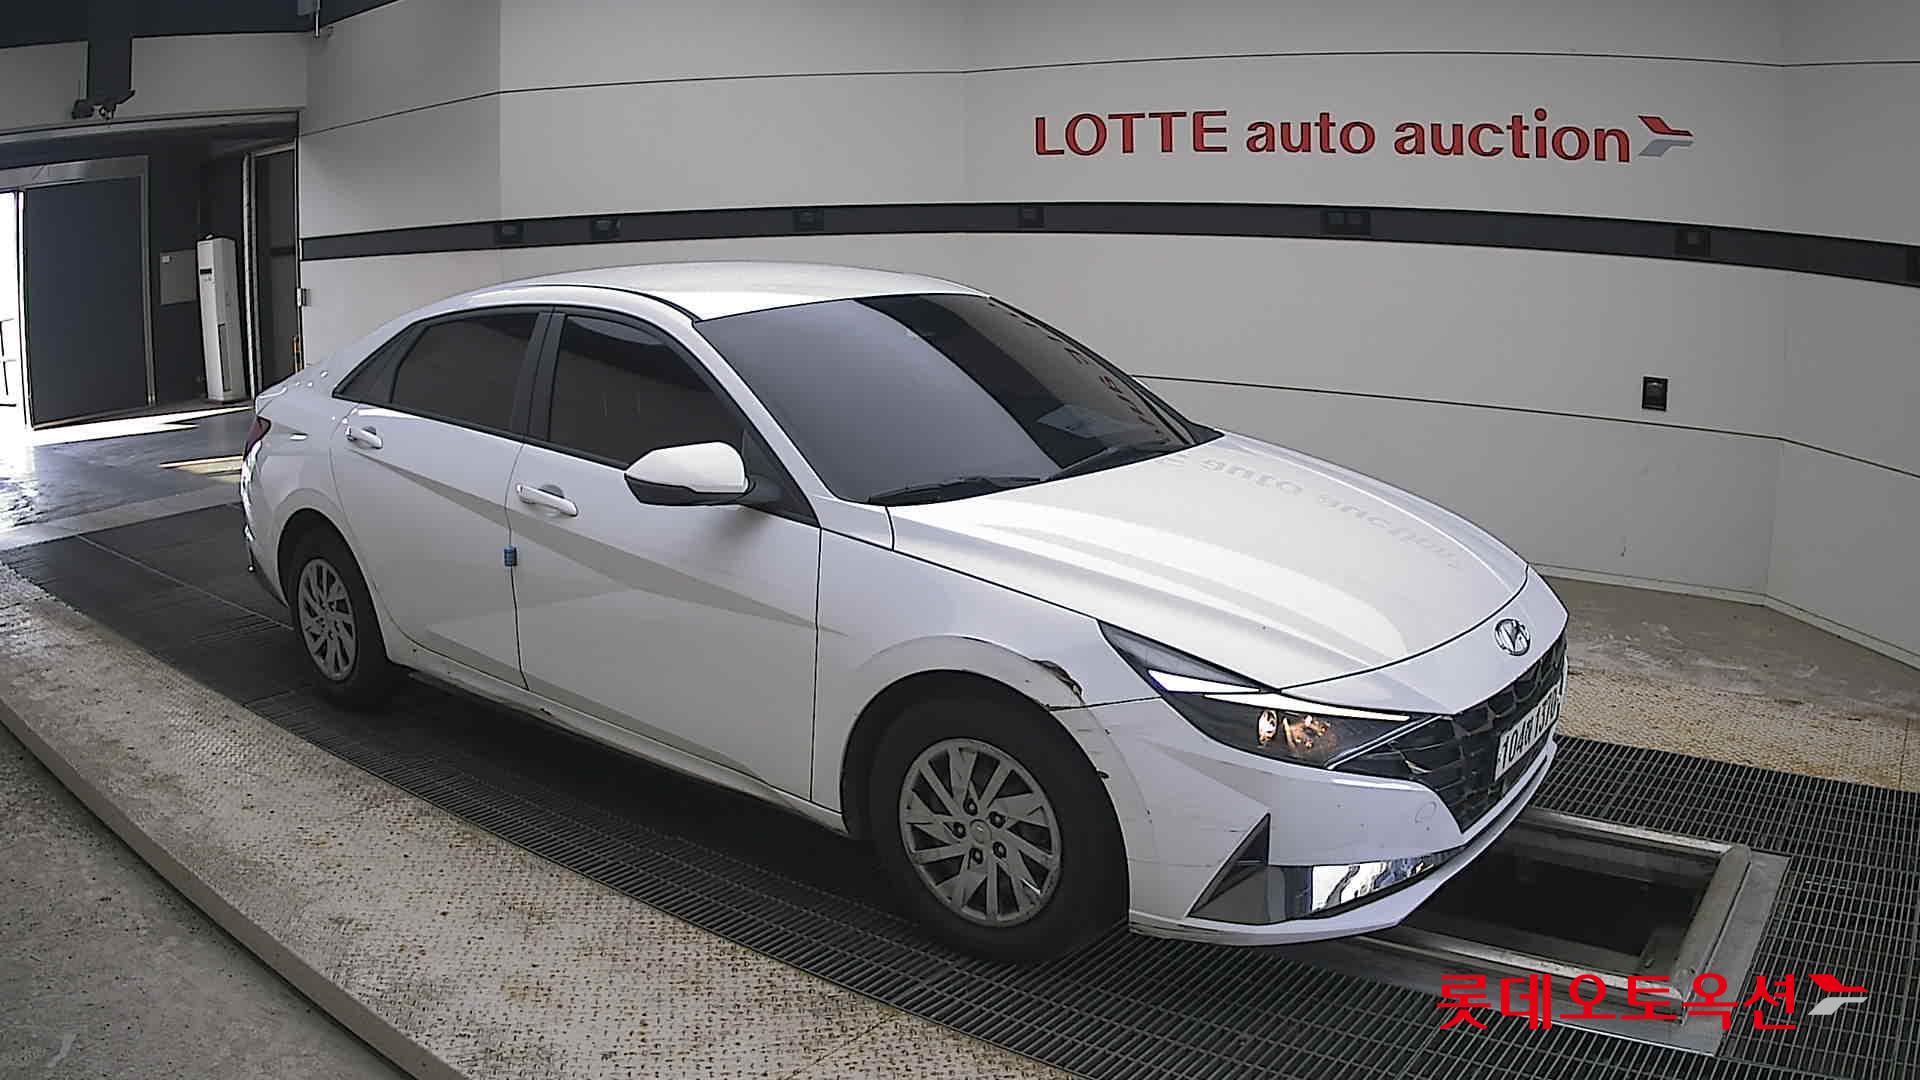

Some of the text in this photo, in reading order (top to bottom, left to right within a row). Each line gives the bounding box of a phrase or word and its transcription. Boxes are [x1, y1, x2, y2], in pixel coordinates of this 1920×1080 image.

[1035, 108, 1630, 163] LOTTE auto auction
